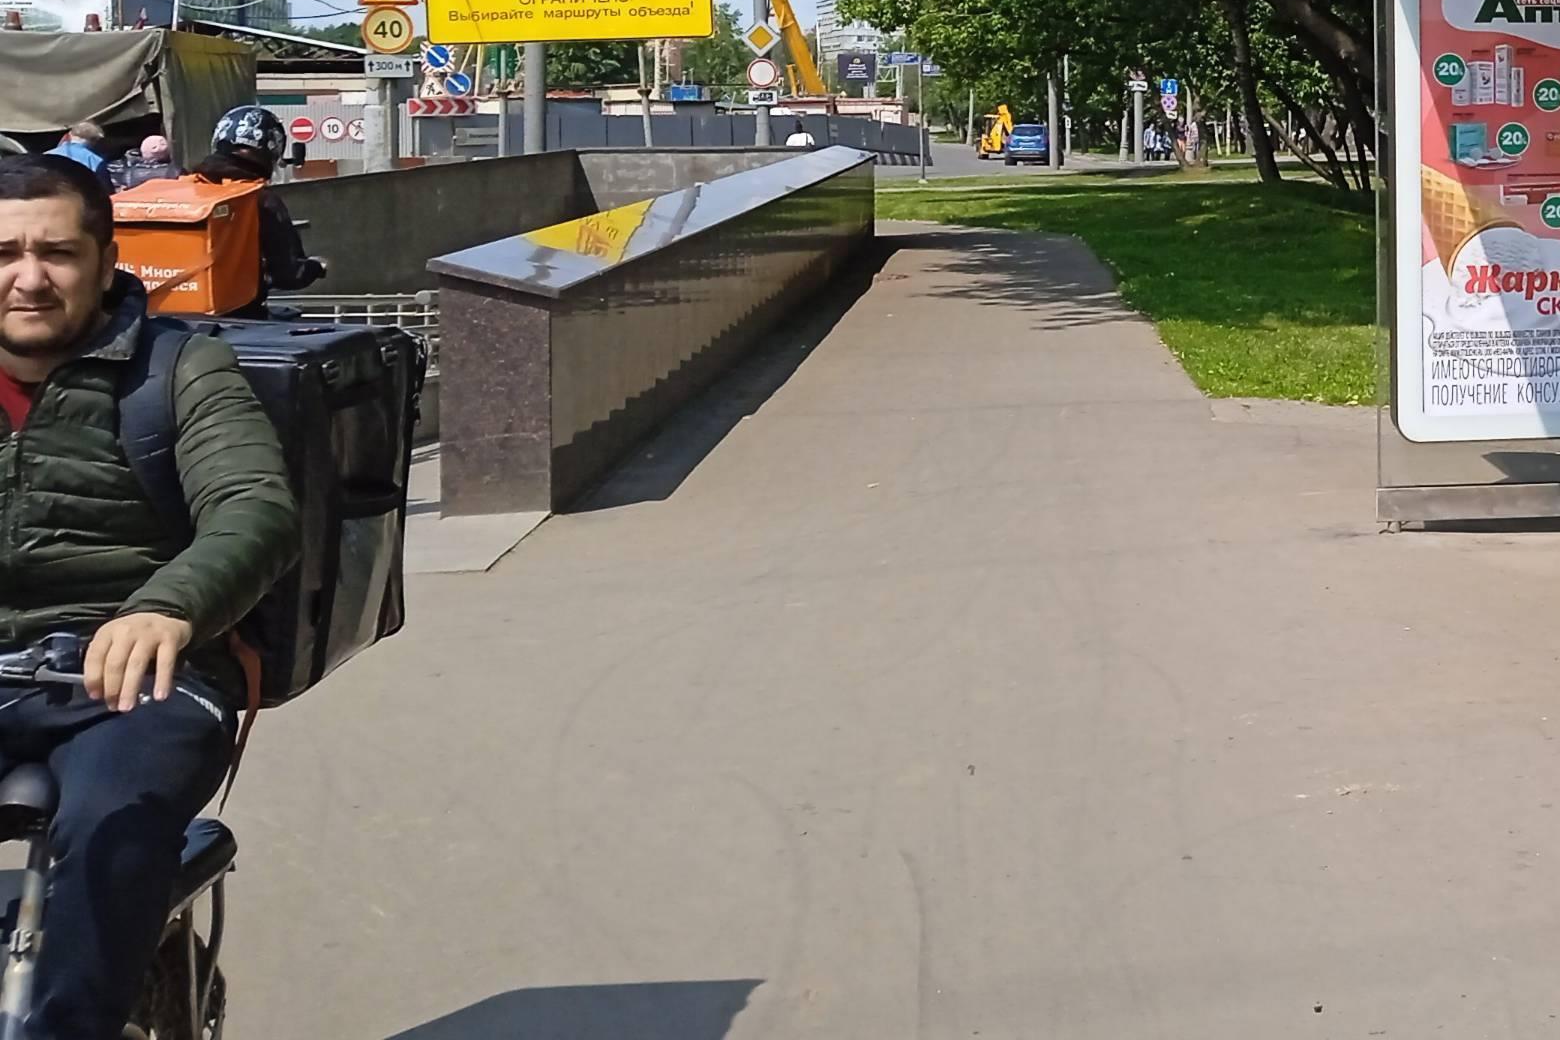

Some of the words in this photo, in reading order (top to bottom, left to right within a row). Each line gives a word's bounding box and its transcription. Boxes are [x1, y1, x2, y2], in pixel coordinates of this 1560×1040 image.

[449, 9, 534, 22] Выбирайте
[544, 8, 620, 20] маршруты
[373, 20, 403, 39] 40
[375, 61, 394, 71] 300
[327, 124, 339, 134] 10
[1432, 358, 1493, 380] ИМЕЮТСЯ
[1432, 382, 1508, 406] ПОЛУЧЕНИЕ
